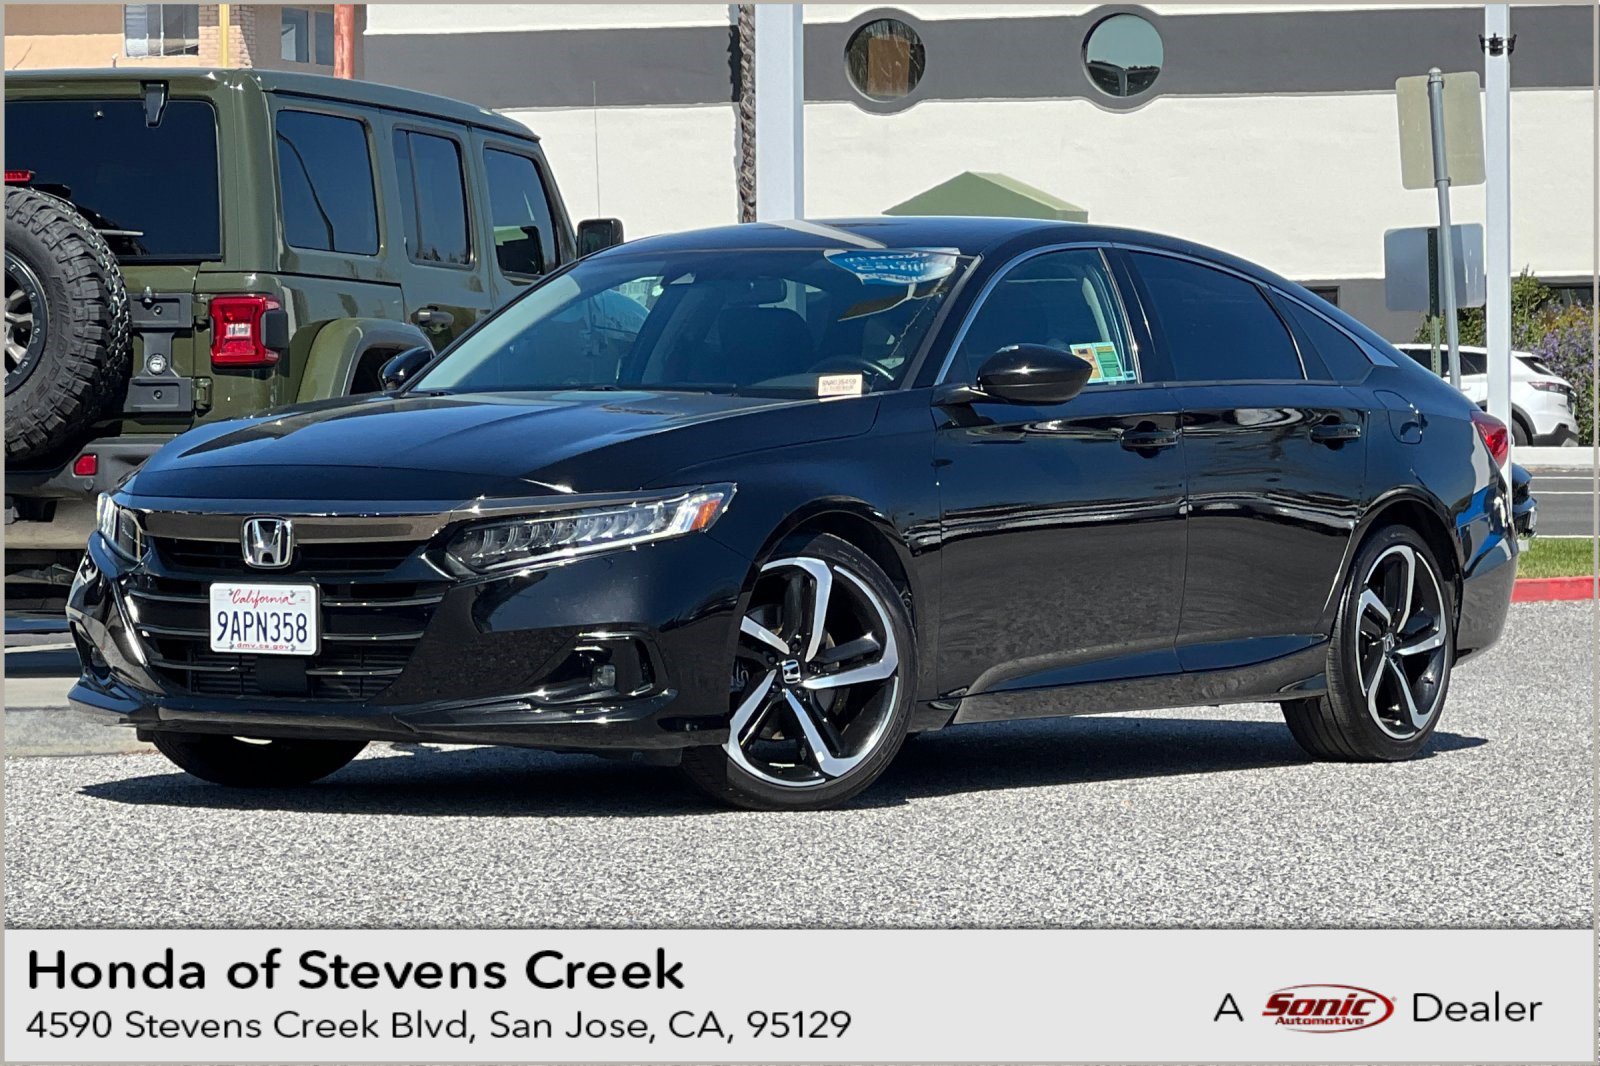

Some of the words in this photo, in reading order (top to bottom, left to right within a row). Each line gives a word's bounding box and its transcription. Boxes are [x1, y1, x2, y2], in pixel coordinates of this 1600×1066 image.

[232, 588, 297, 609] California
[216, 610, 308, 644] 9APN358
[236, 642, 290, 650] dmv.ca.gov
